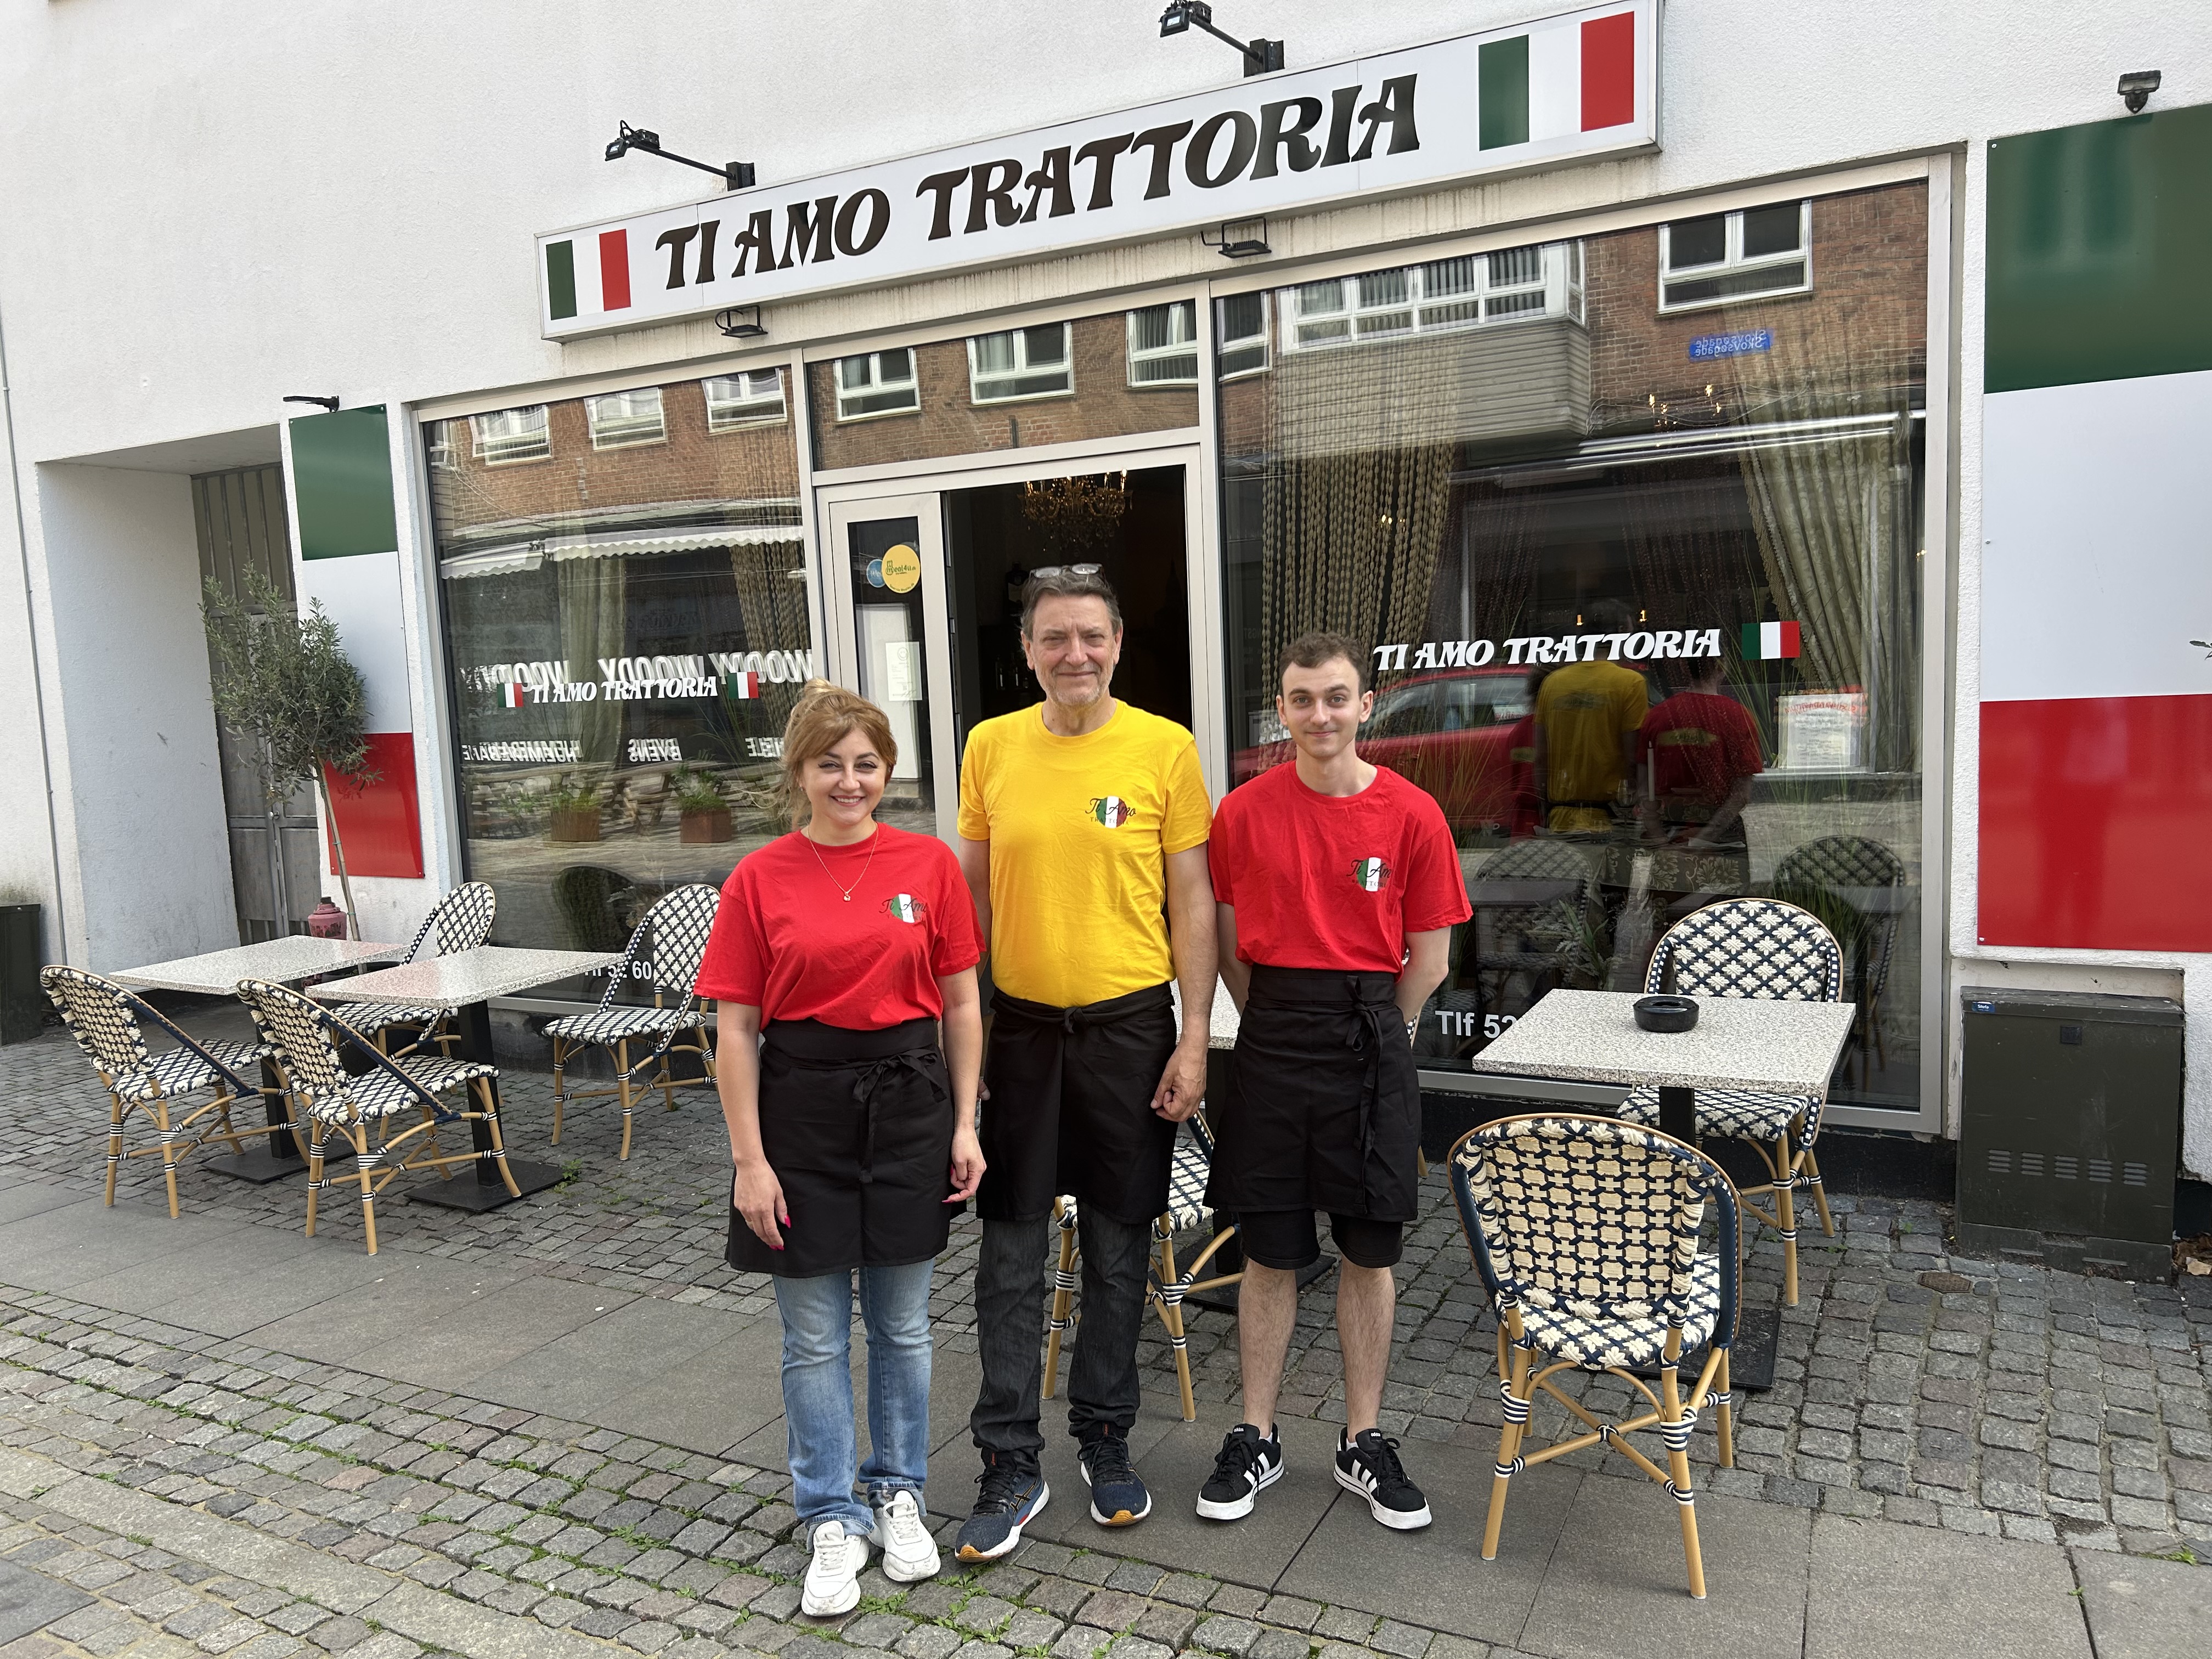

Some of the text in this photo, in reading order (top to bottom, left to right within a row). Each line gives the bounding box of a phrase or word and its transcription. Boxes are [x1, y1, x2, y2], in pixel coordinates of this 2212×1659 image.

[655, 73, 1421, 291] TI AMO TRATTORIA
[1372, 629, 1722, 670] TI AMO TRATTORIA
[533, 675, 719, 703] TI AMO TRATTORIA
[1365, 862, 1392, 878] Am
[632, 960, 652, 980] 60
[1435, 1010, 1475, 1036] Tlf
